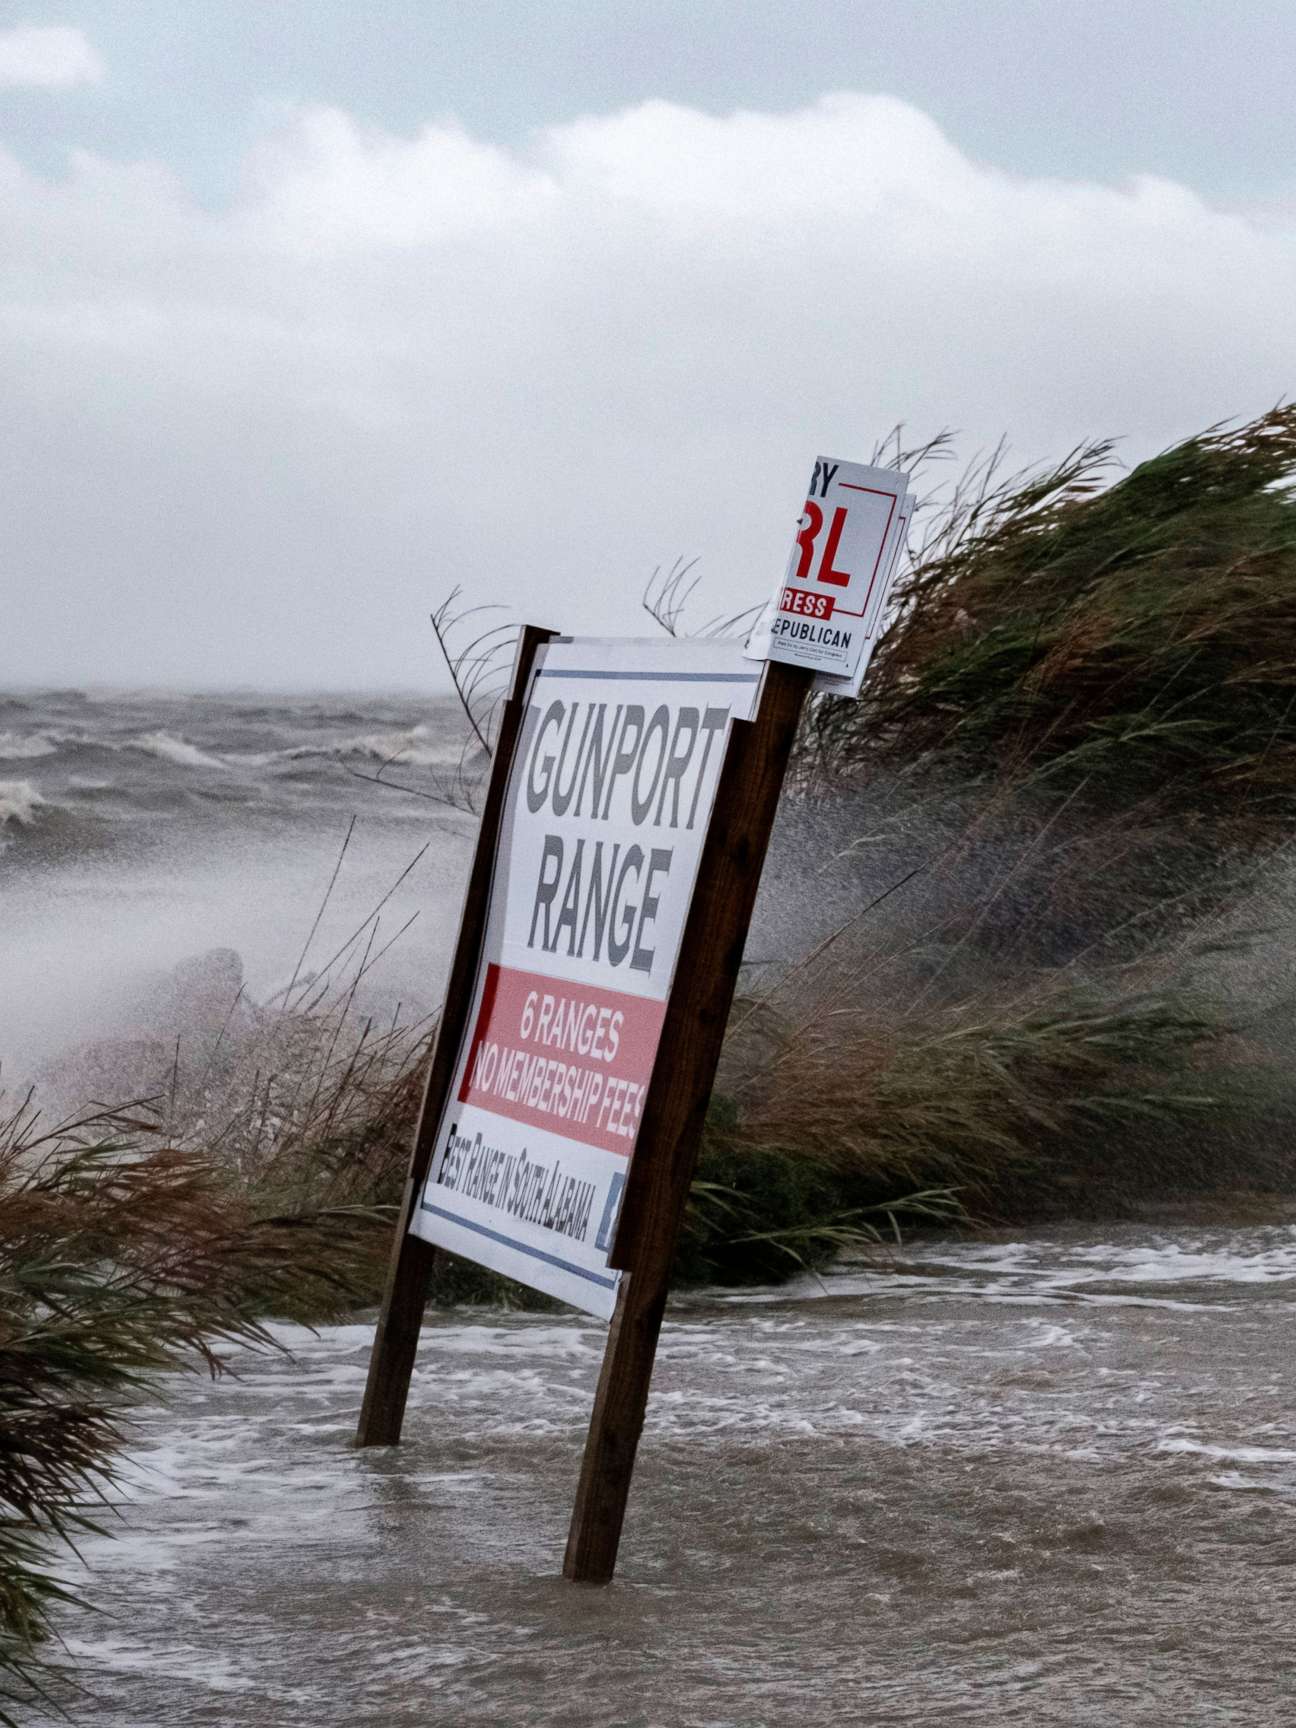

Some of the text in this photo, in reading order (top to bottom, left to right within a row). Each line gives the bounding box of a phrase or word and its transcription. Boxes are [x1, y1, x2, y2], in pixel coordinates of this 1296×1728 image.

[771, 618, 852, 649] EPUBLICAN
[780, 590, 827, 618] RESS
[526, 699, 731, 831] GUNPORT
[527, 834, 674, 973] RANGE
[519, 991, 624, 1062] 6 RANGES
[468, 1040, 645, 1139] NO MEMBERSHIP FEES
[437, 1123, 473, 1194] BEST
[462, 1132, 506, 1206] RANGE
[495, 1154, 516, 1210] IN
[507, 1148, 549, 1225] SOUTH
[538, 1159, 597, 1242] ALABAMA
